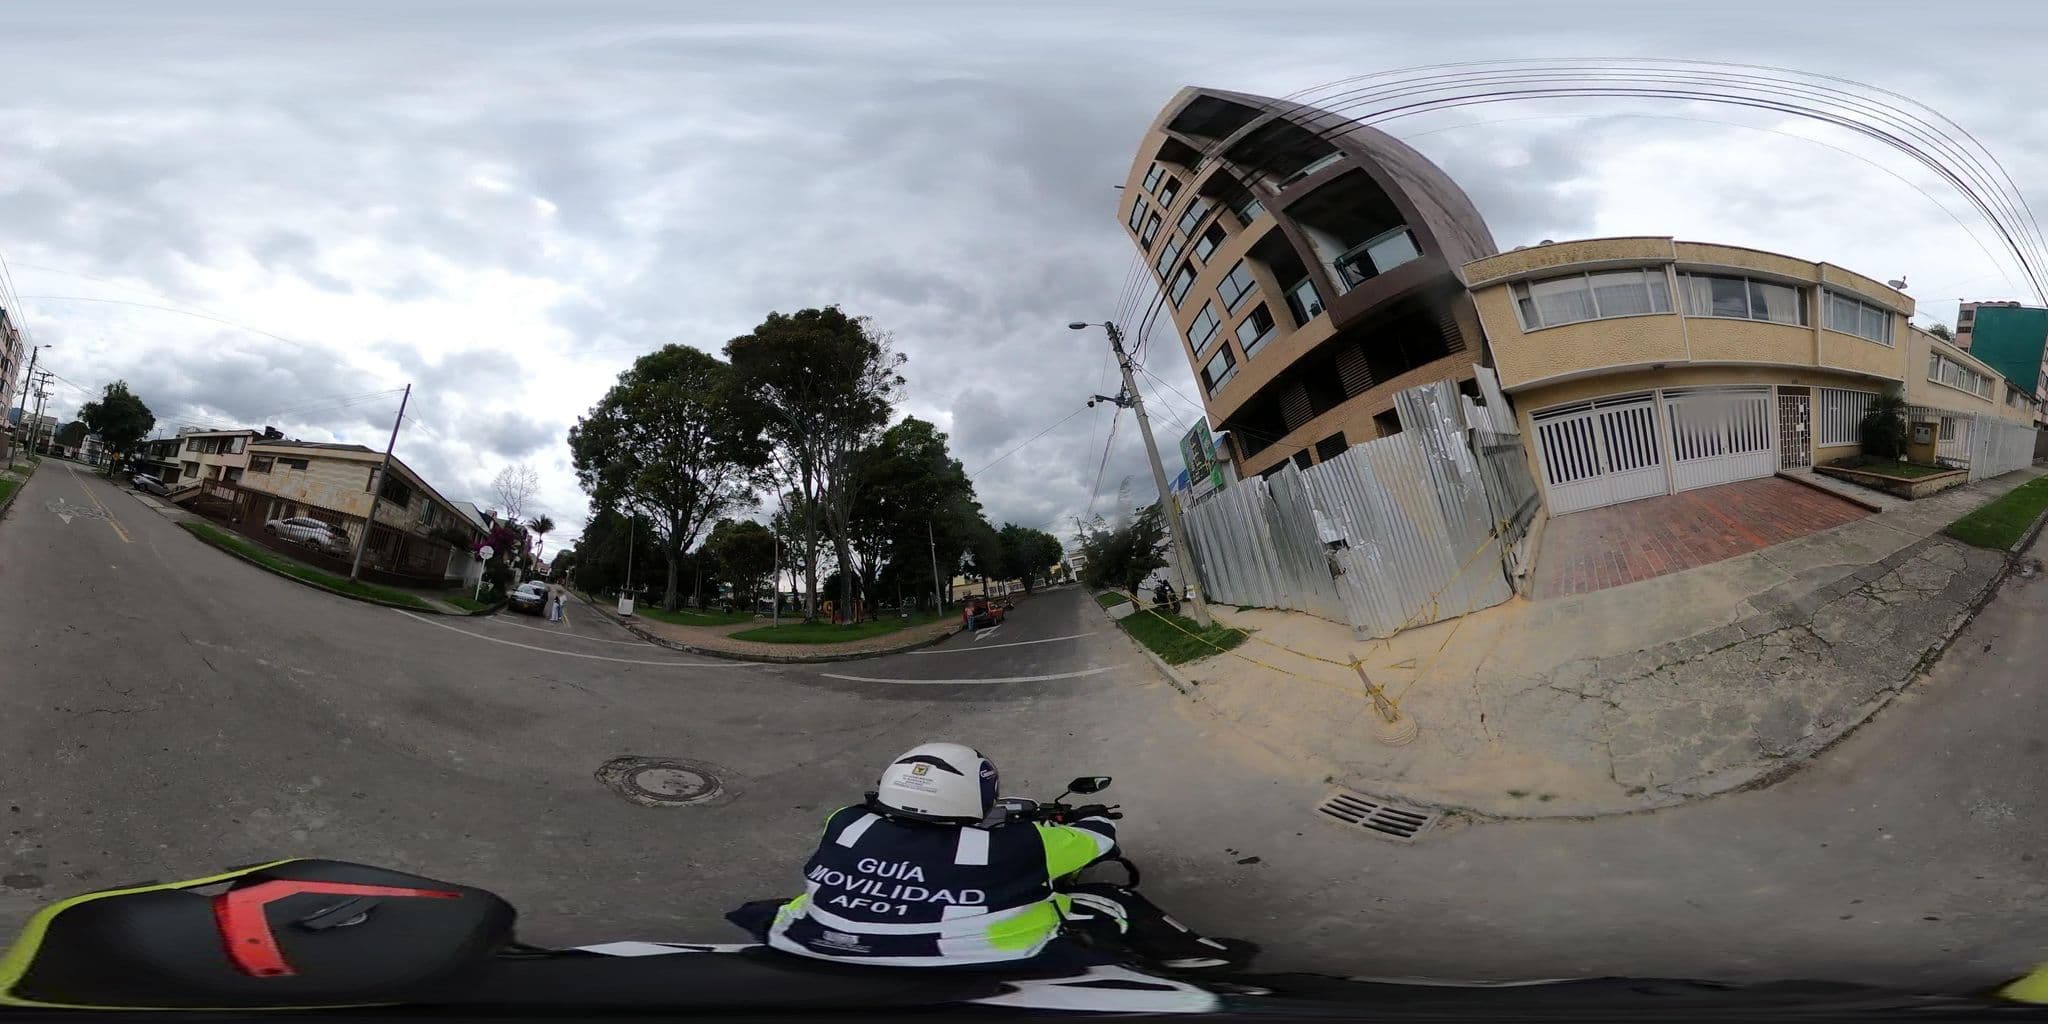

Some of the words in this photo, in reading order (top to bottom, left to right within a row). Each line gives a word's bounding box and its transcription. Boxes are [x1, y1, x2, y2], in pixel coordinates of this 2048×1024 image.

[857, 857, 925, 883] GUÍA
[807, 864, 986, 905] MOVILIDAD
[829, 894, 909, 916] AF01
